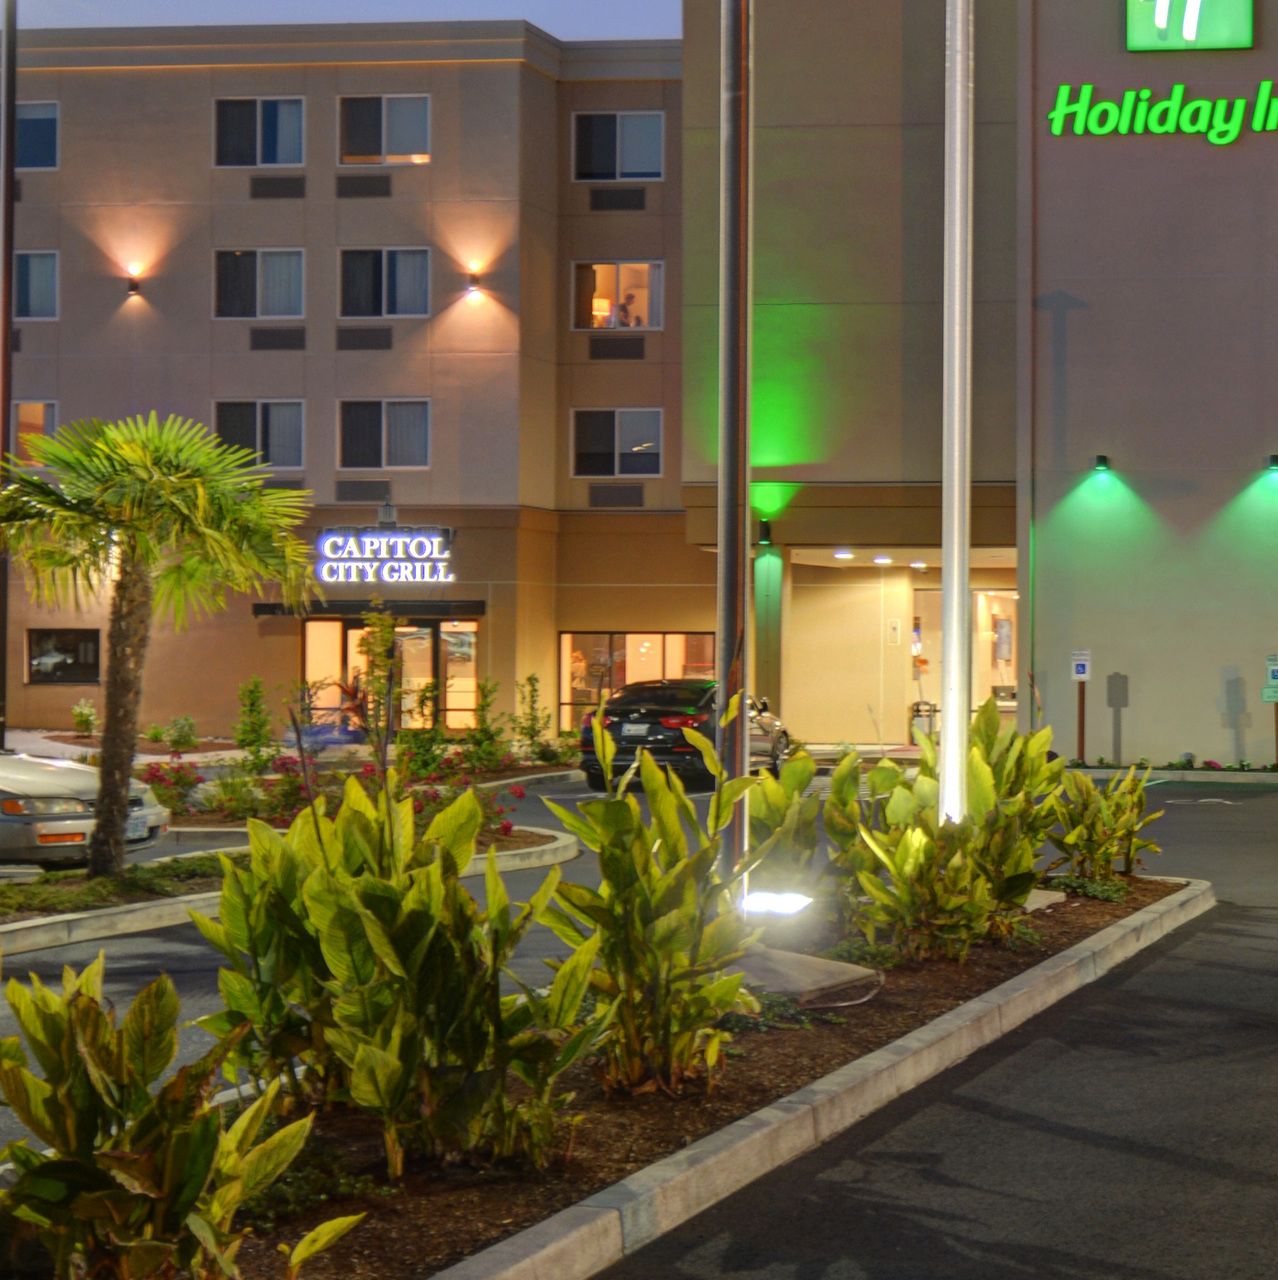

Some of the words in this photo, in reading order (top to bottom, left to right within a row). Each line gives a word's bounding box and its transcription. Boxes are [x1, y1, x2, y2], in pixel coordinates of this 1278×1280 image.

[1048, 83, 1247, 145] Holiday
[323, 536, 450, 559] CAPITOL
[321, 561, 379, 583] CITY
[382, 561, 456, 583] GRILL
